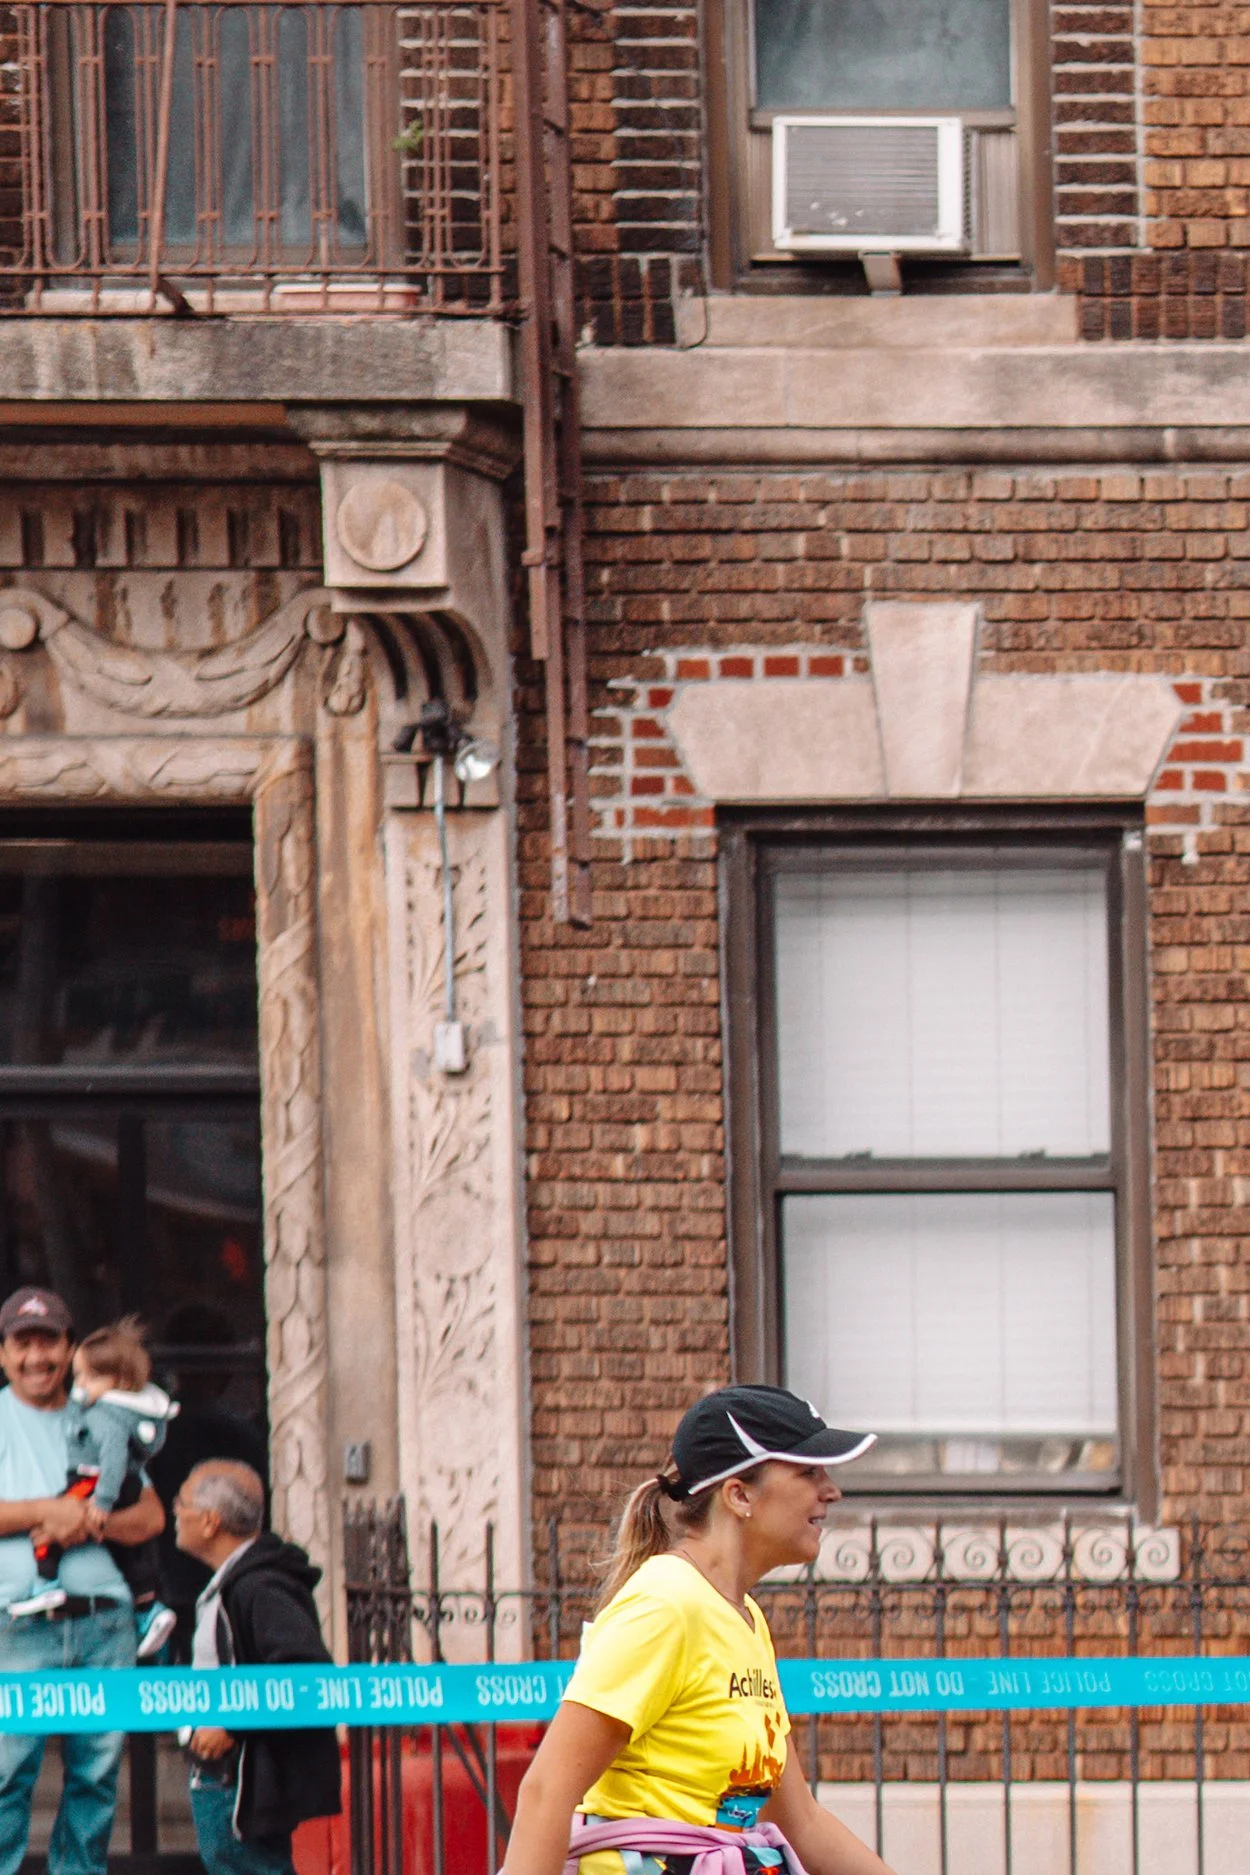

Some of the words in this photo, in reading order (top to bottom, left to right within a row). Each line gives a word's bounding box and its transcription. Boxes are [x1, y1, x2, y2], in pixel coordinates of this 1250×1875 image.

[138, 1679, 211, 1715] CROSS
[217, 1678, 260, 1713] NOT
[265, 1678, 295, 1712] DO
[315, 1676, 363, 1711] LINE
[367, 1675, 444, 1709] POLICE
[475, 1674, 547, 1707] CROSS
[728, 1668, 774, 1700] Achilles
[811, 1670, 882, 1699] CROSS
[889, 1670, 931, 1698] NOT
[936, 1670, 964, 1696] DO
[988, 1671, 1031, 1696] LINE
[1043, 1671, 1112, 1693] POLICE
[30, 1682, 106, 1718] POLICE
